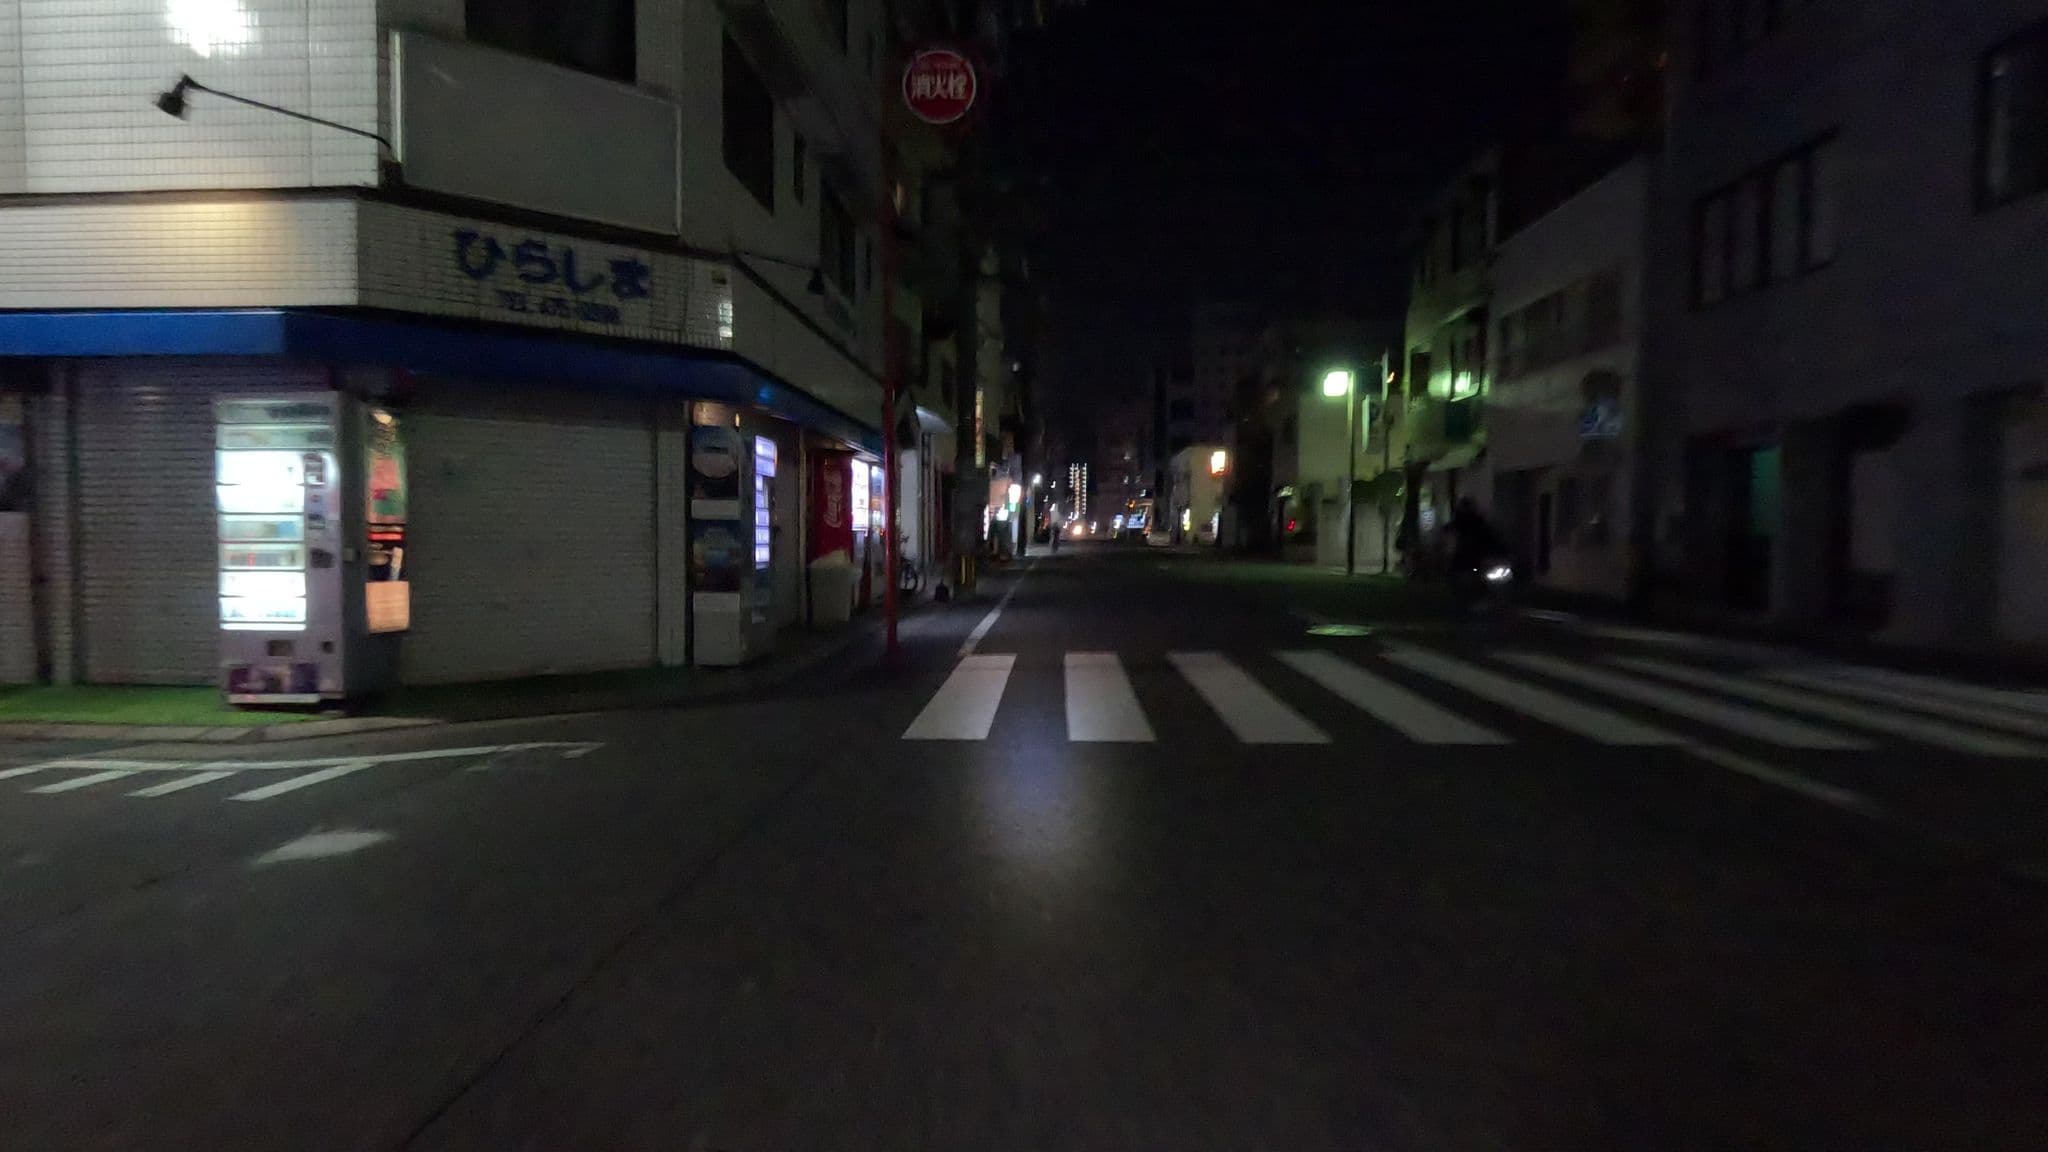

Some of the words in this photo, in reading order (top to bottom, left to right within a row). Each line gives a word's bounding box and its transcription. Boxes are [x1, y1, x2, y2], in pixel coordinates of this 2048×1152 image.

[911, 71, 968, 100] 消火栓
[456, 230, 650, 298] ひらしま
